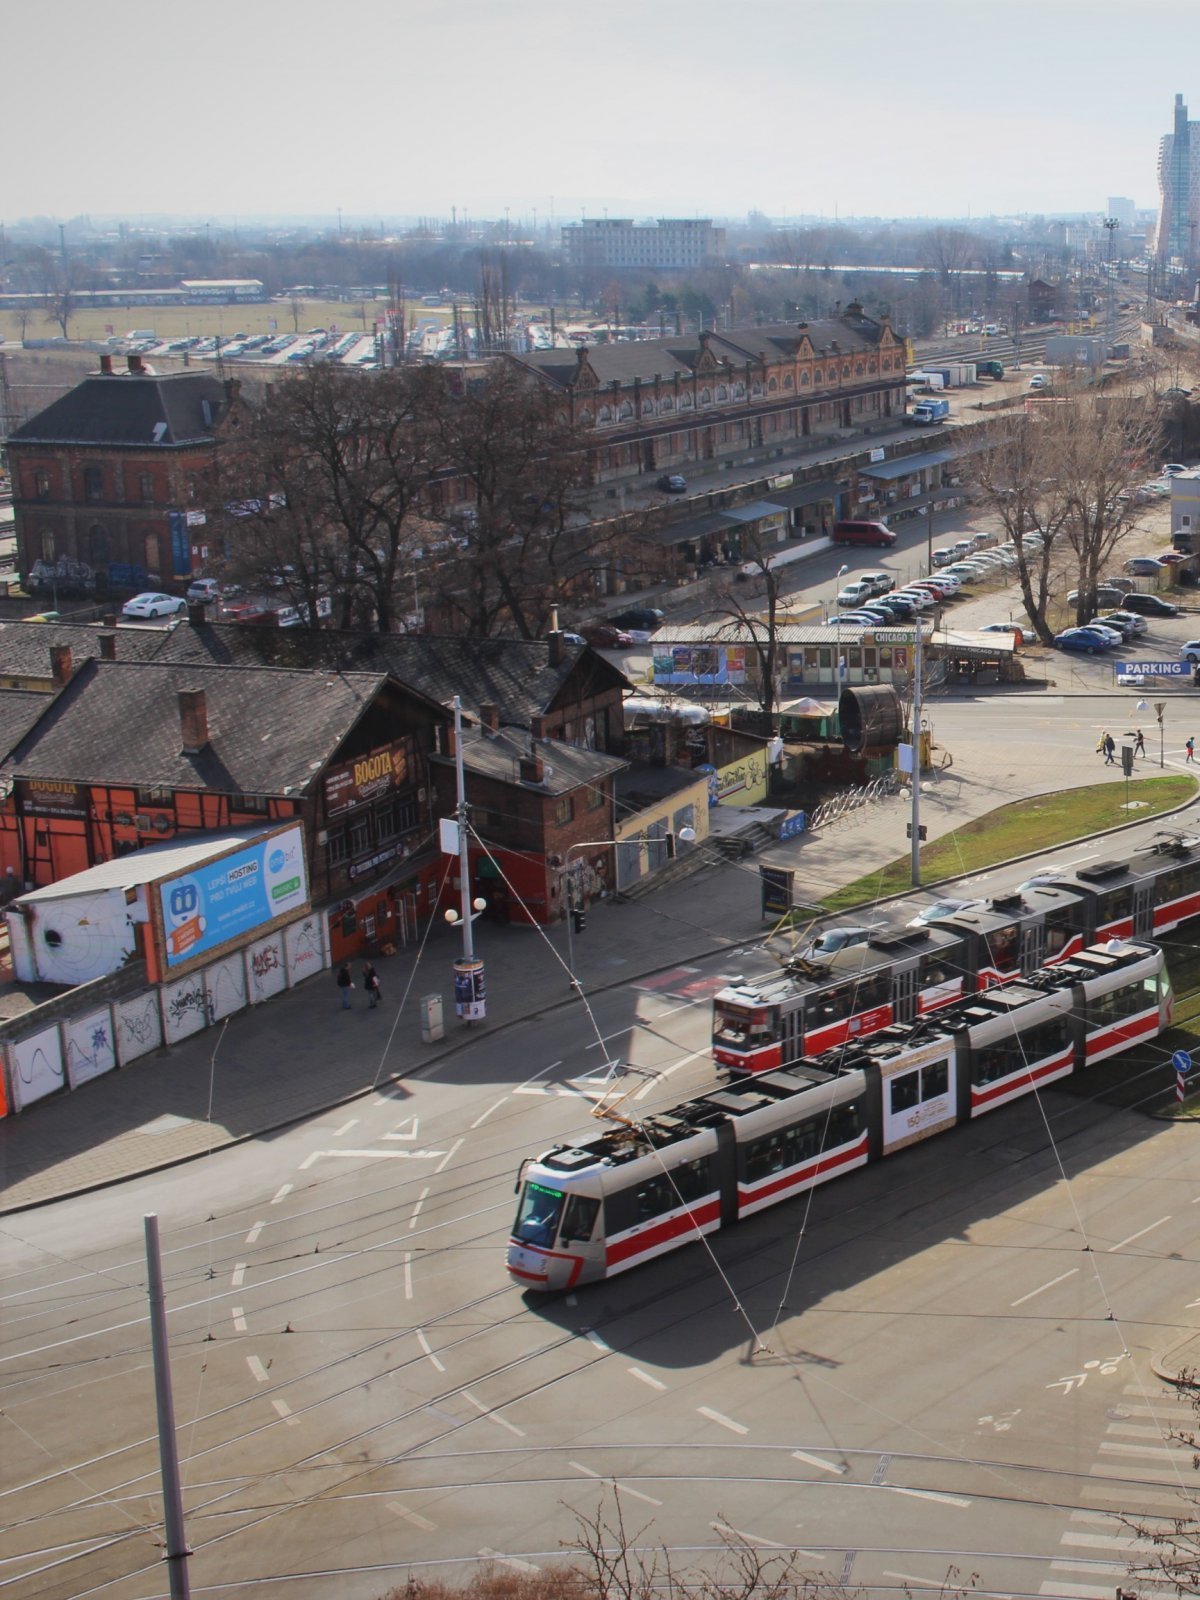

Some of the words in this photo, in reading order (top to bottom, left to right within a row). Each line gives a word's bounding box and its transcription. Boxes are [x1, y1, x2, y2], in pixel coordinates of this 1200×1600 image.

[875, 632, 908, 643] CHICAGO
[1125, 663, 1182, 674] PARKING
[354, 752, 393, 786] BOGOTA
[229, 862, 258, 881] HOSTING
[210, 890, 224, 903] PRO
[243, 876, 257, 889] WEB
